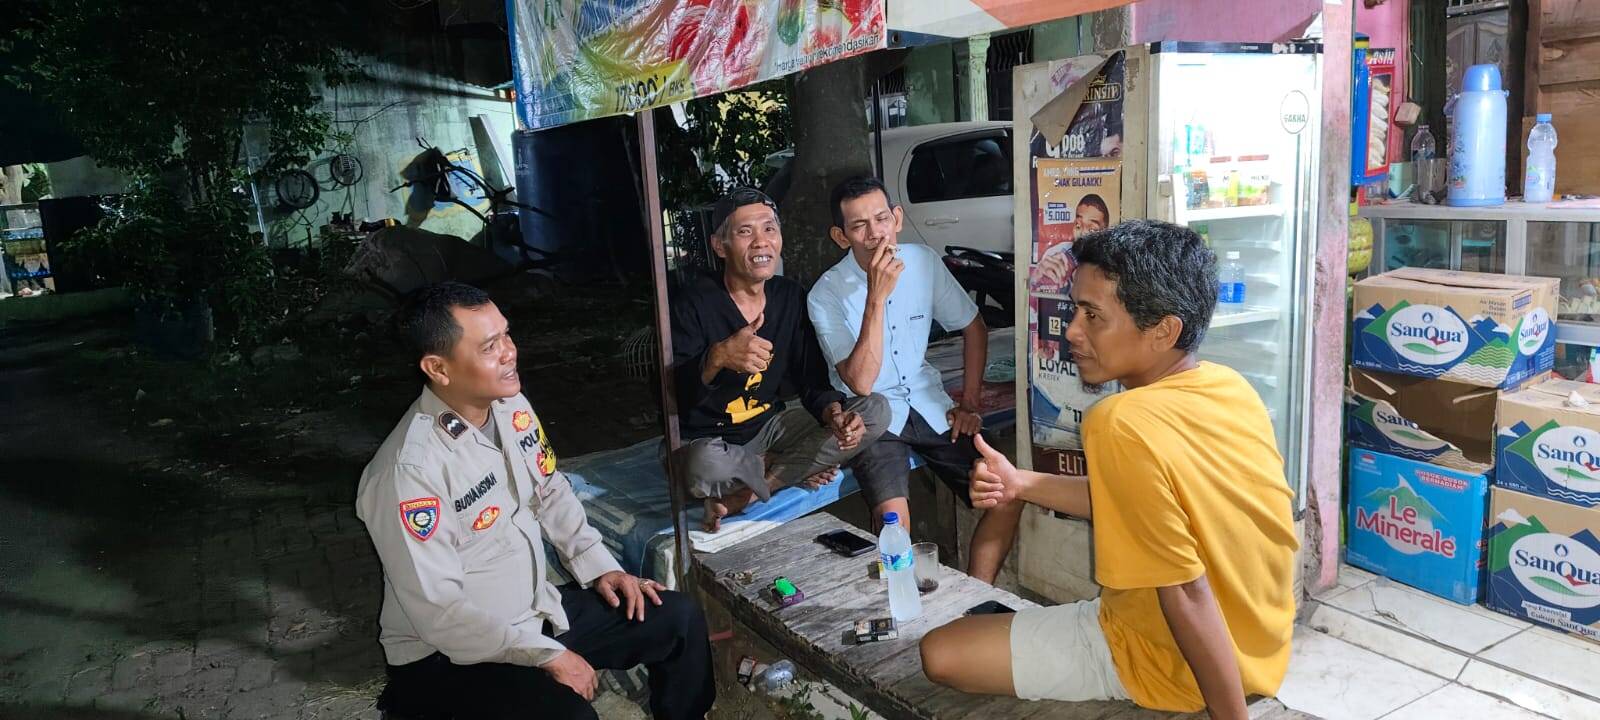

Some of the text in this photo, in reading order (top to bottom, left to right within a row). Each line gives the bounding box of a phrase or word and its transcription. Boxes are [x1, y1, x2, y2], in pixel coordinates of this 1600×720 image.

[1050, 319, 1060, 330] 12
[1390, 321, 1463, 346] SanQua
[1520, 318, 1548, 340] SanQua
[1039, 358, 1076, 377] LOYAL
[1389, 495, 1418, 526] Le
[1356, 505, 1456, 558] Minerale
[1515, 548, 1600, 586] SanQua
